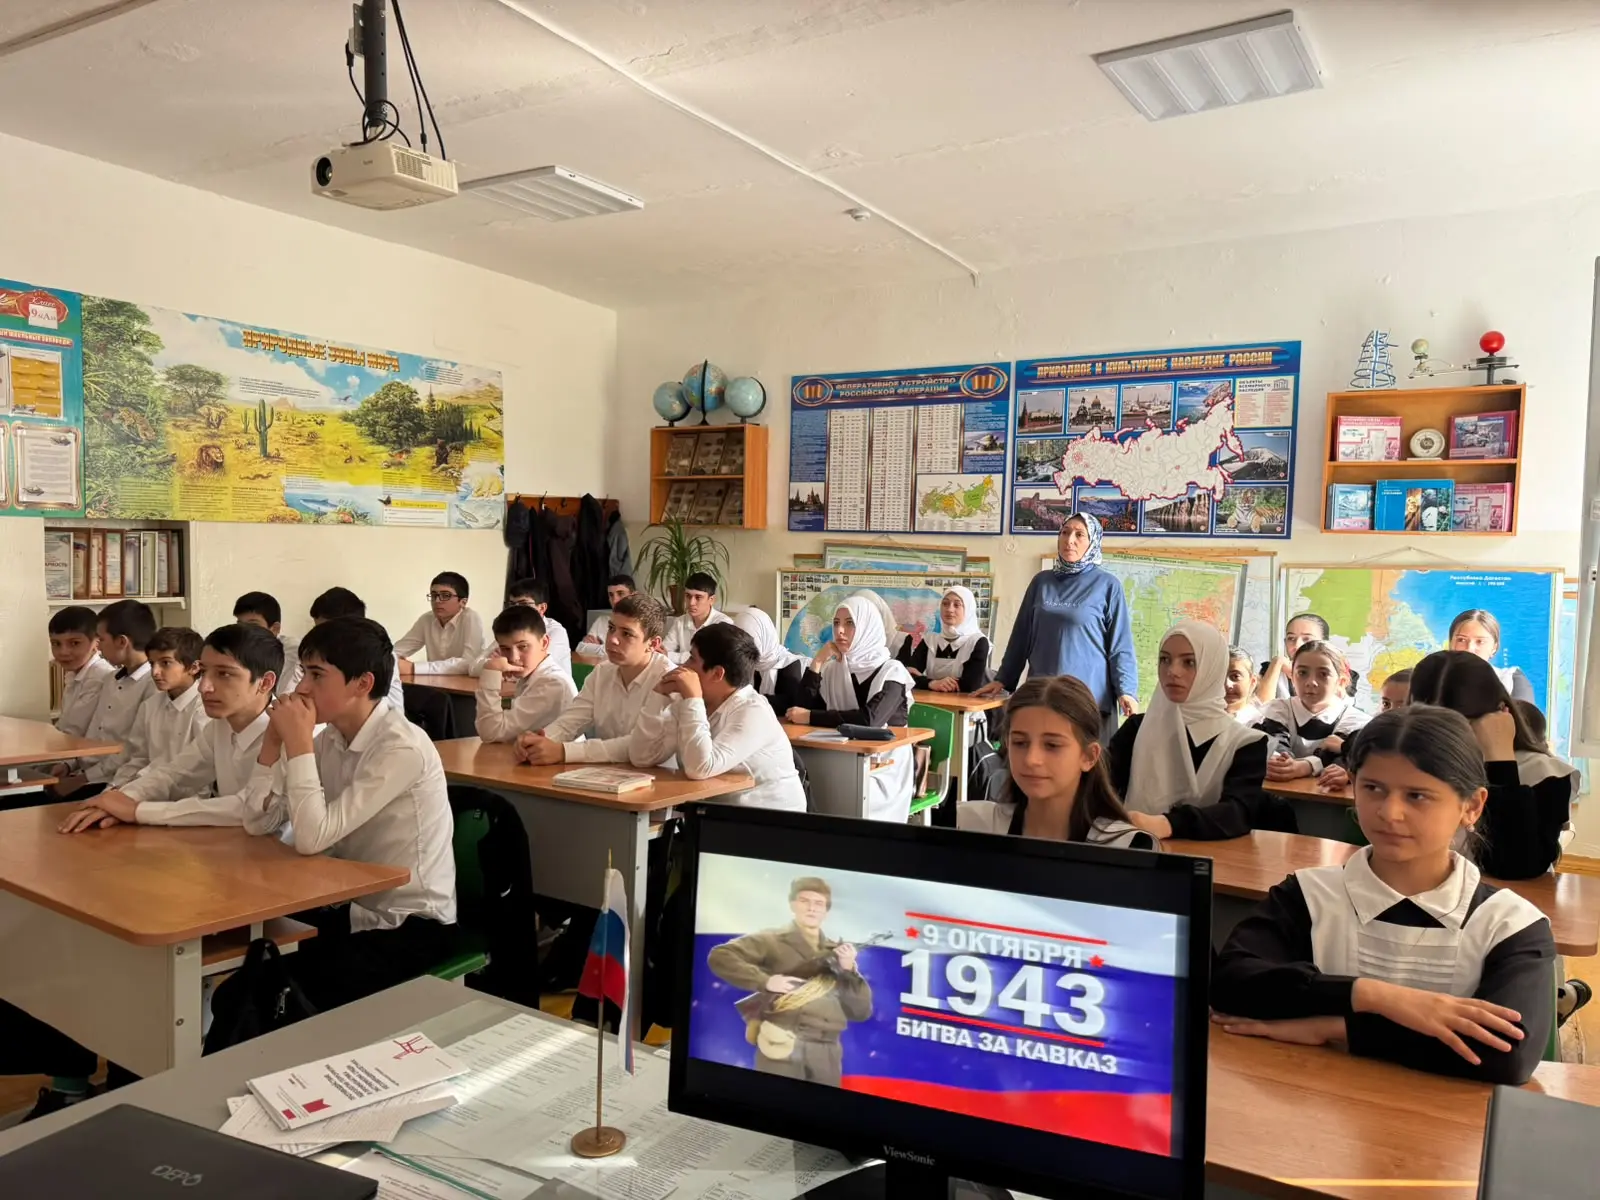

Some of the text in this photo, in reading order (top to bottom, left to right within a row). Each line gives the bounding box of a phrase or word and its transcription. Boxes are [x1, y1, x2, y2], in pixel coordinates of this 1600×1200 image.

[243, 330, 327, 361] ПРИРОДНЫЕ
[328, 345, 366, 368] ЗОНЫ
[367, 352, 401, 373] МИРА
[1037, 351, 1273, 379] ПРИРОДНОЕ И КУЛЬТУРНОЕ НАСЛЕДИЕ РОССИИ
[836, 377, 956, 390] ФЕДЕРАТИВНОЕ УСТРОЙСТВО
[839, 385, 949, 398] РОССИЙСКОЙ ФЕДЕРАЦИИ
[923, 925, 1083, 969] 9 ОКТЯБРЯ
[900, 948, 1105, 1038] 1943
[896, 1016, 1118, 1076] БИТВА ЗА КАВКАЗ
[883, 1144, 936, 1166] ViewSonic
